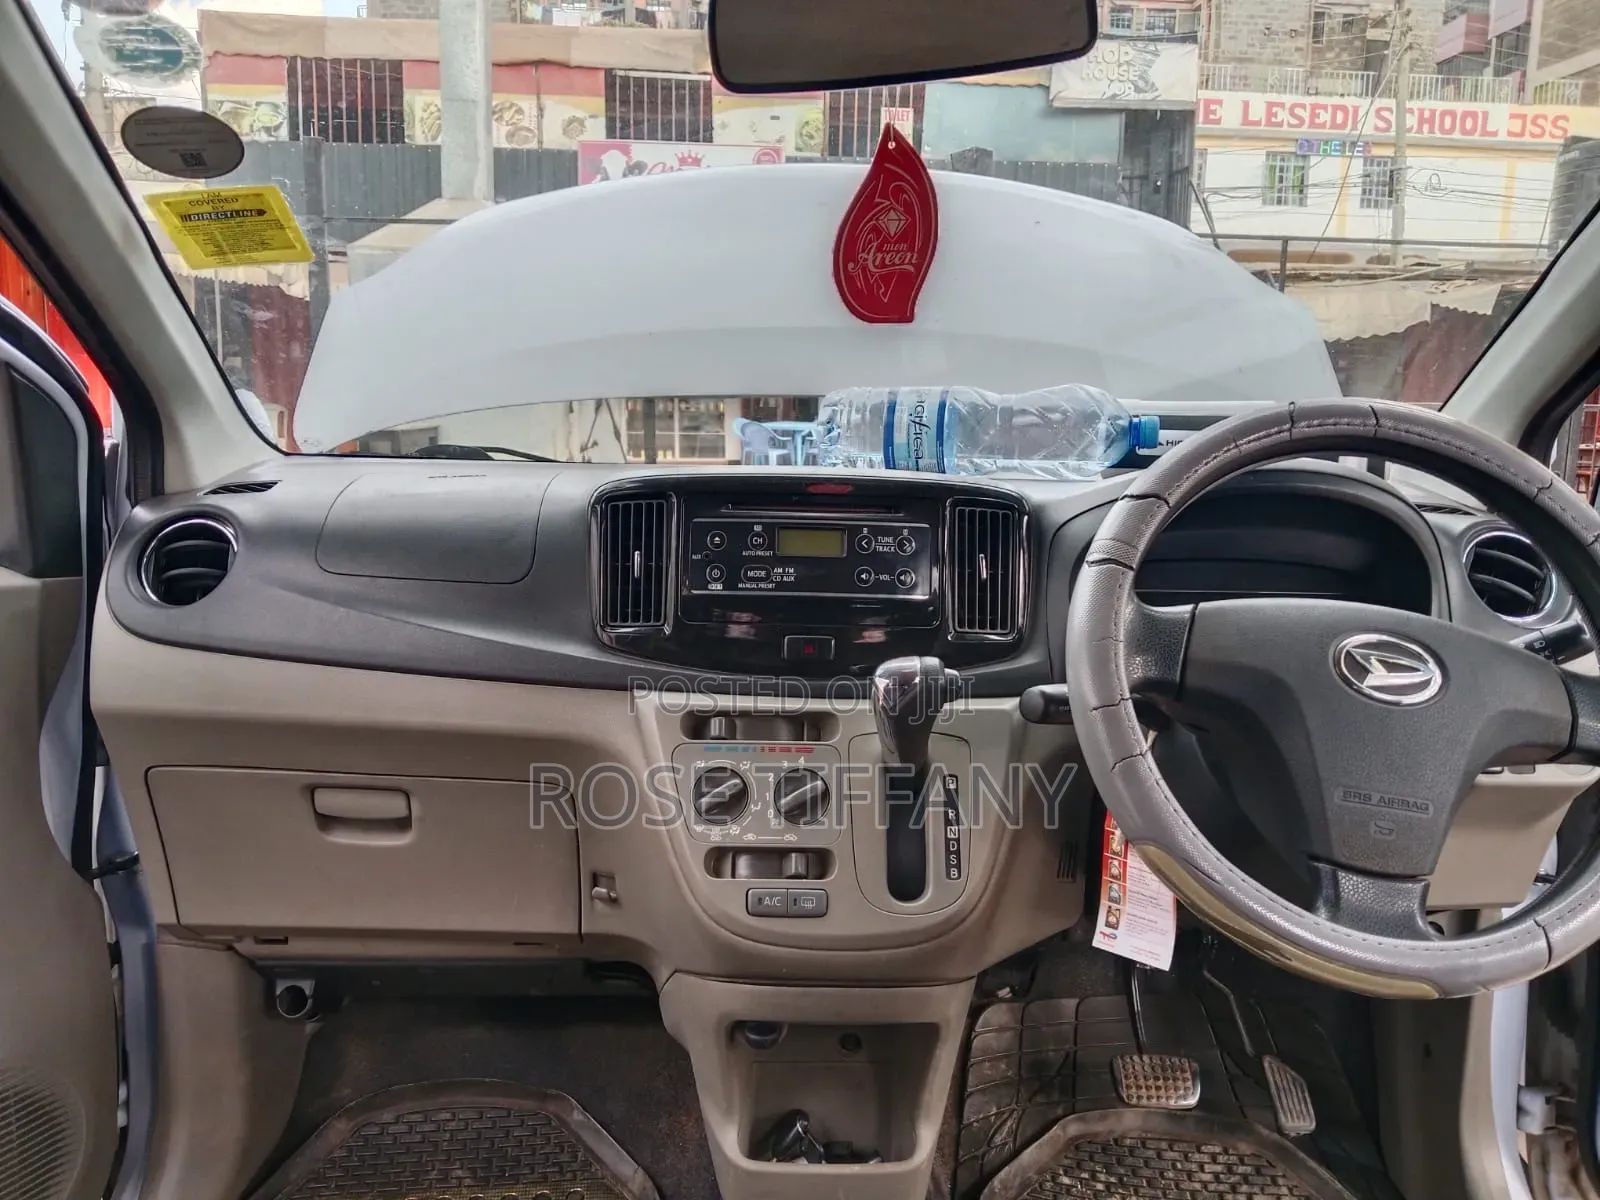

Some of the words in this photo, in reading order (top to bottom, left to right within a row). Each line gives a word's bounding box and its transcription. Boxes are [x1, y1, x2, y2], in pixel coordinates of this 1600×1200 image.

[1240, 99, 1360, 132] LESEDI
[1507, 113, 1570, 140] JSS
[188, 197, 239, 207] COVERED
[882, 242, 907, 251] mon
[848, 241, 918, 273] Areon
[752, 537, 763, 545] CH
[747, 570, 767, 578] MODE
[798, 756, 805, 764] 4
[768, 773, 774, 782] 2
[946, 778, 956, 788] P
[1377, 795, 1430, 812] AIRBAG
[948, 809, 956, 820] R
[948, 826, 957, 837] N
[949, 841, 957, 851] D
[949, 854, 957, 865] S
[950, 868, 958, 878] B
[764, 896, 781, 906] A/C
